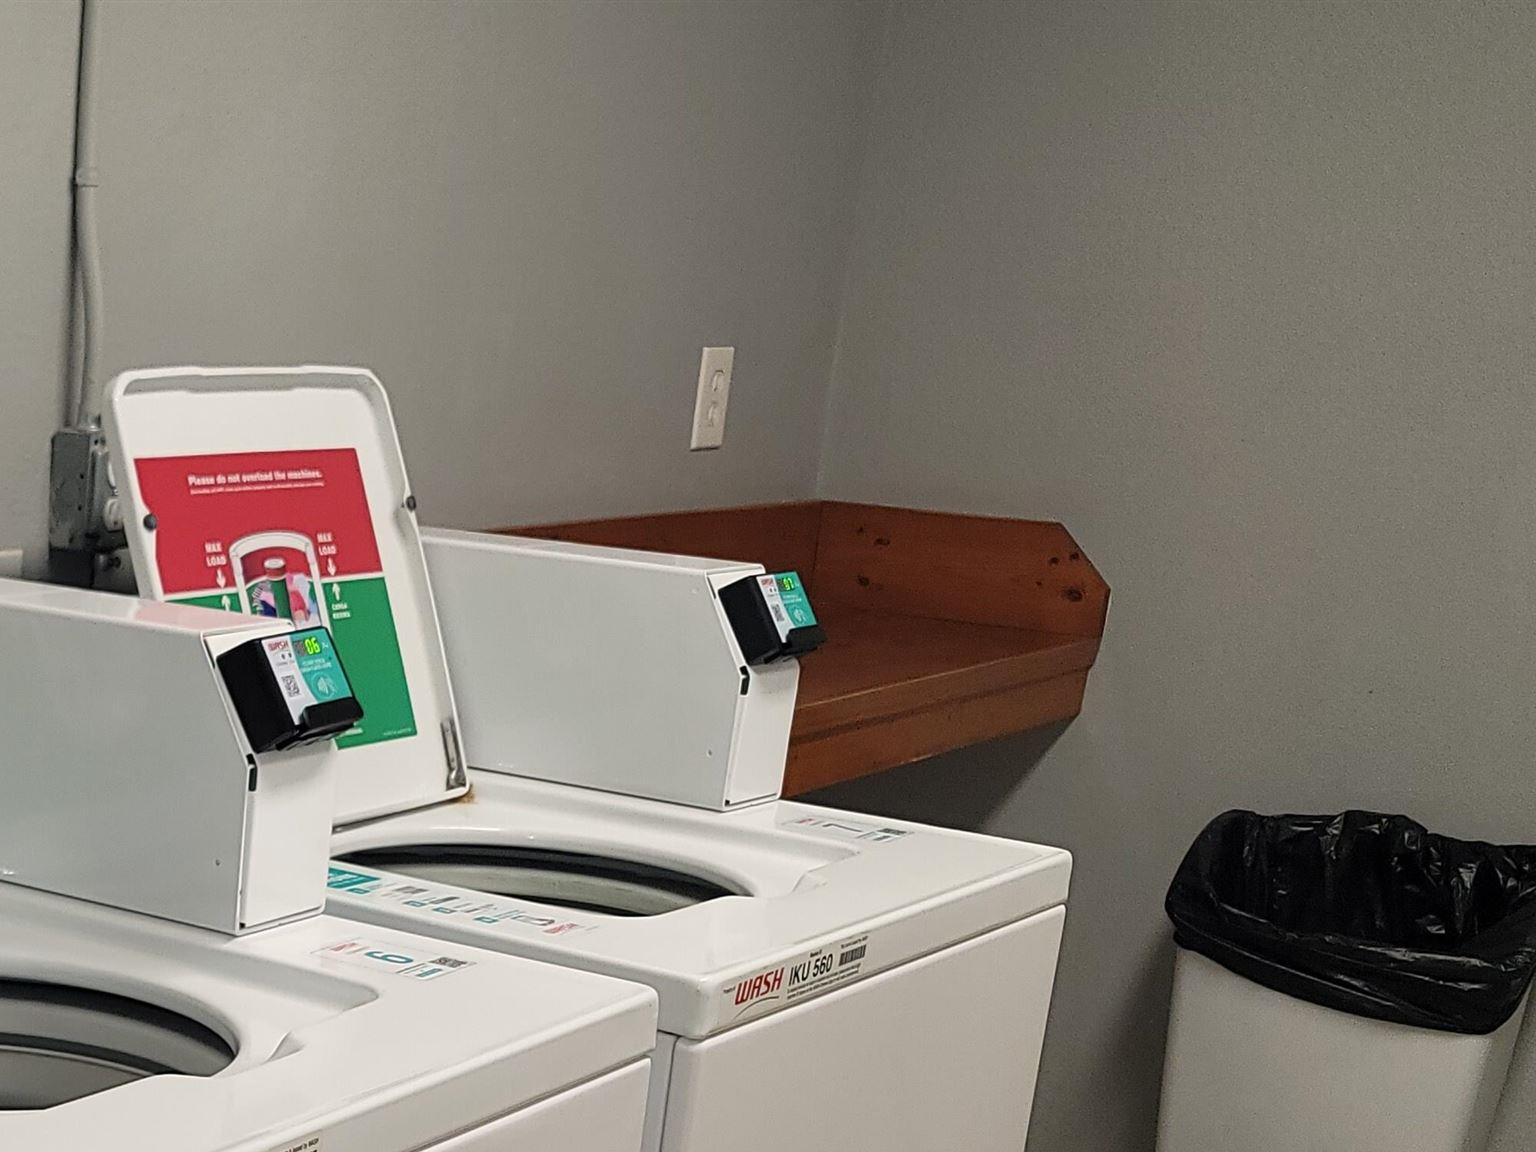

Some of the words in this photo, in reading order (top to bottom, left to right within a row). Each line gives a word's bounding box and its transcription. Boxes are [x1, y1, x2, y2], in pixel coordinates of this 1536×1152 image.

[187, 474, 214, 486] Please
[216, 474, 227, 485] do
[227, 473, 241, 484] not
[242, 470, 273, 483] overload
[274, 470, 287, 481] the
[318, 545, 336, 556] LOAD
[206, 555, 226, 567] LOAD
[305, 637, 321, 655] 06
[788, 960, 811, 986] IKU
[812, 953, 834, 978] 560
[735, 967, 785, 1006] WASH
